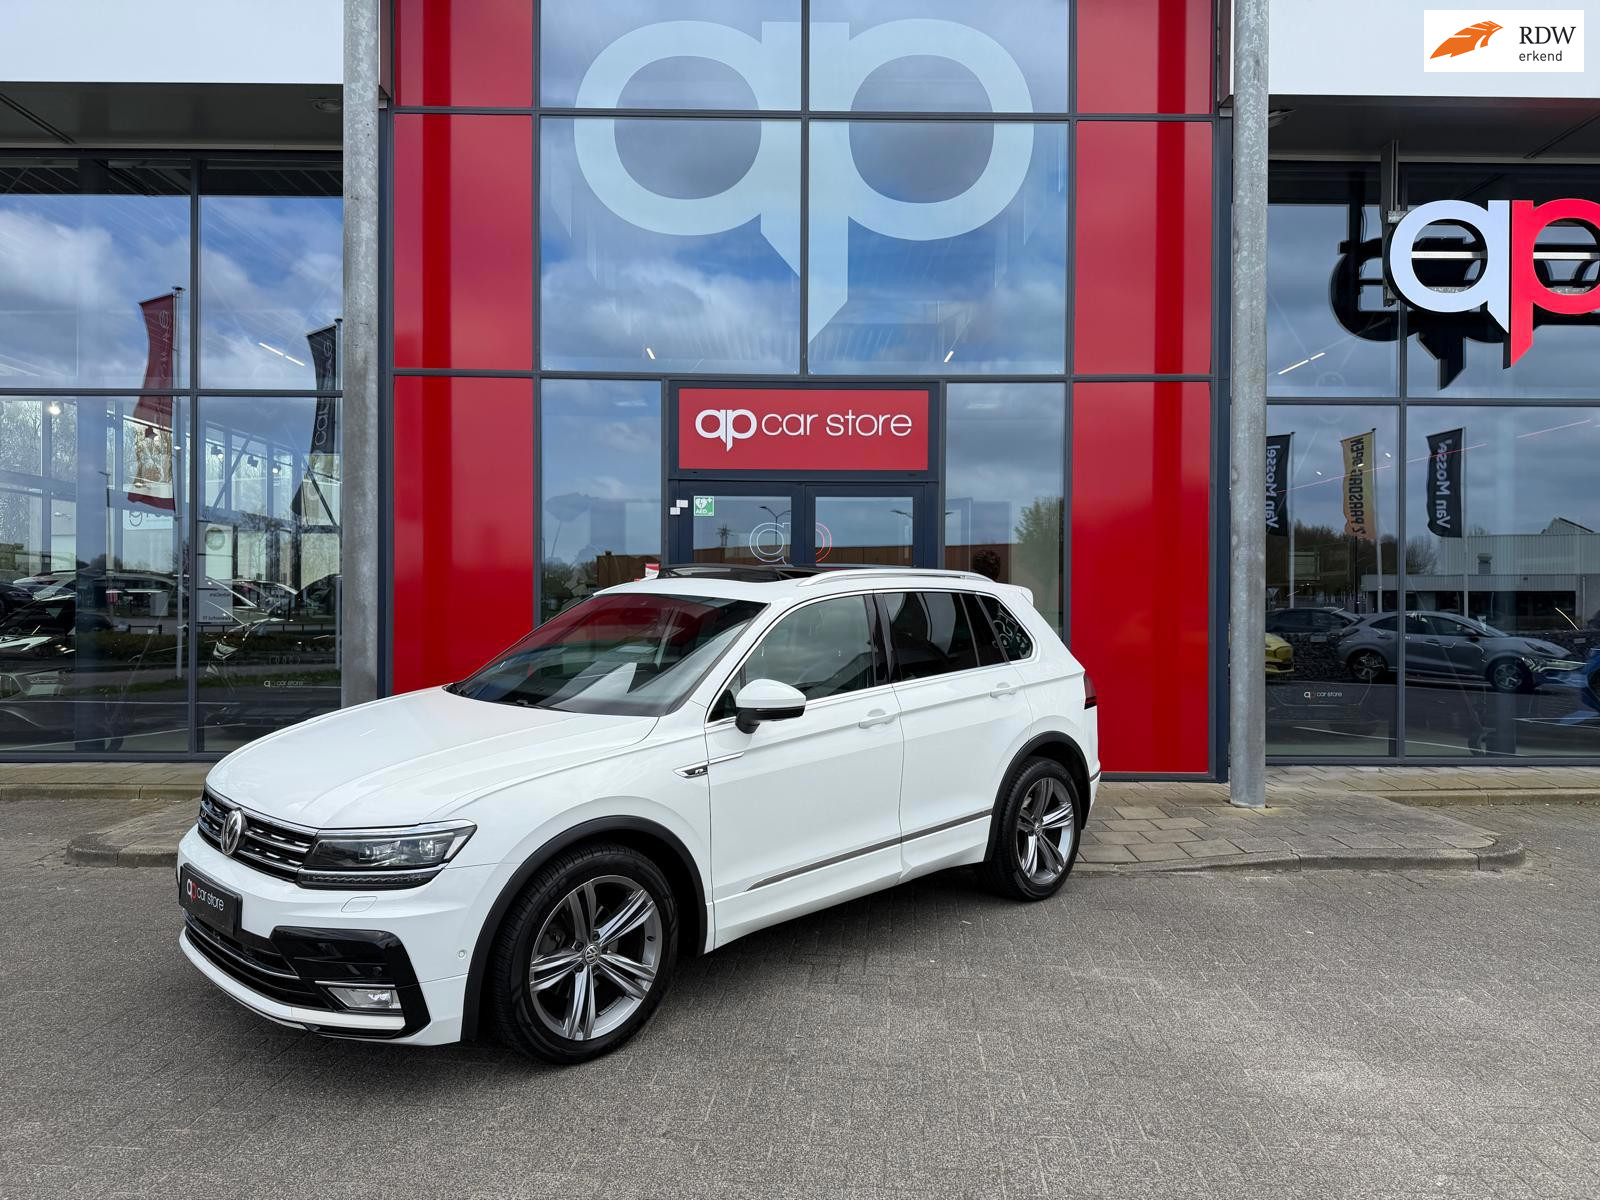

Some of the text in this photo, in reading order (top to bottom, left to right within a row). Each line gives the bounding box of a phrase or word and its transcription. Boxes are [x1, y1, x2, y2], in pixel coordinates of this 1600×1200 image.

[695, 409, 913, 452] ap car store
[196, 887, 207, 902] car
[206, 892, 225, 911] store
